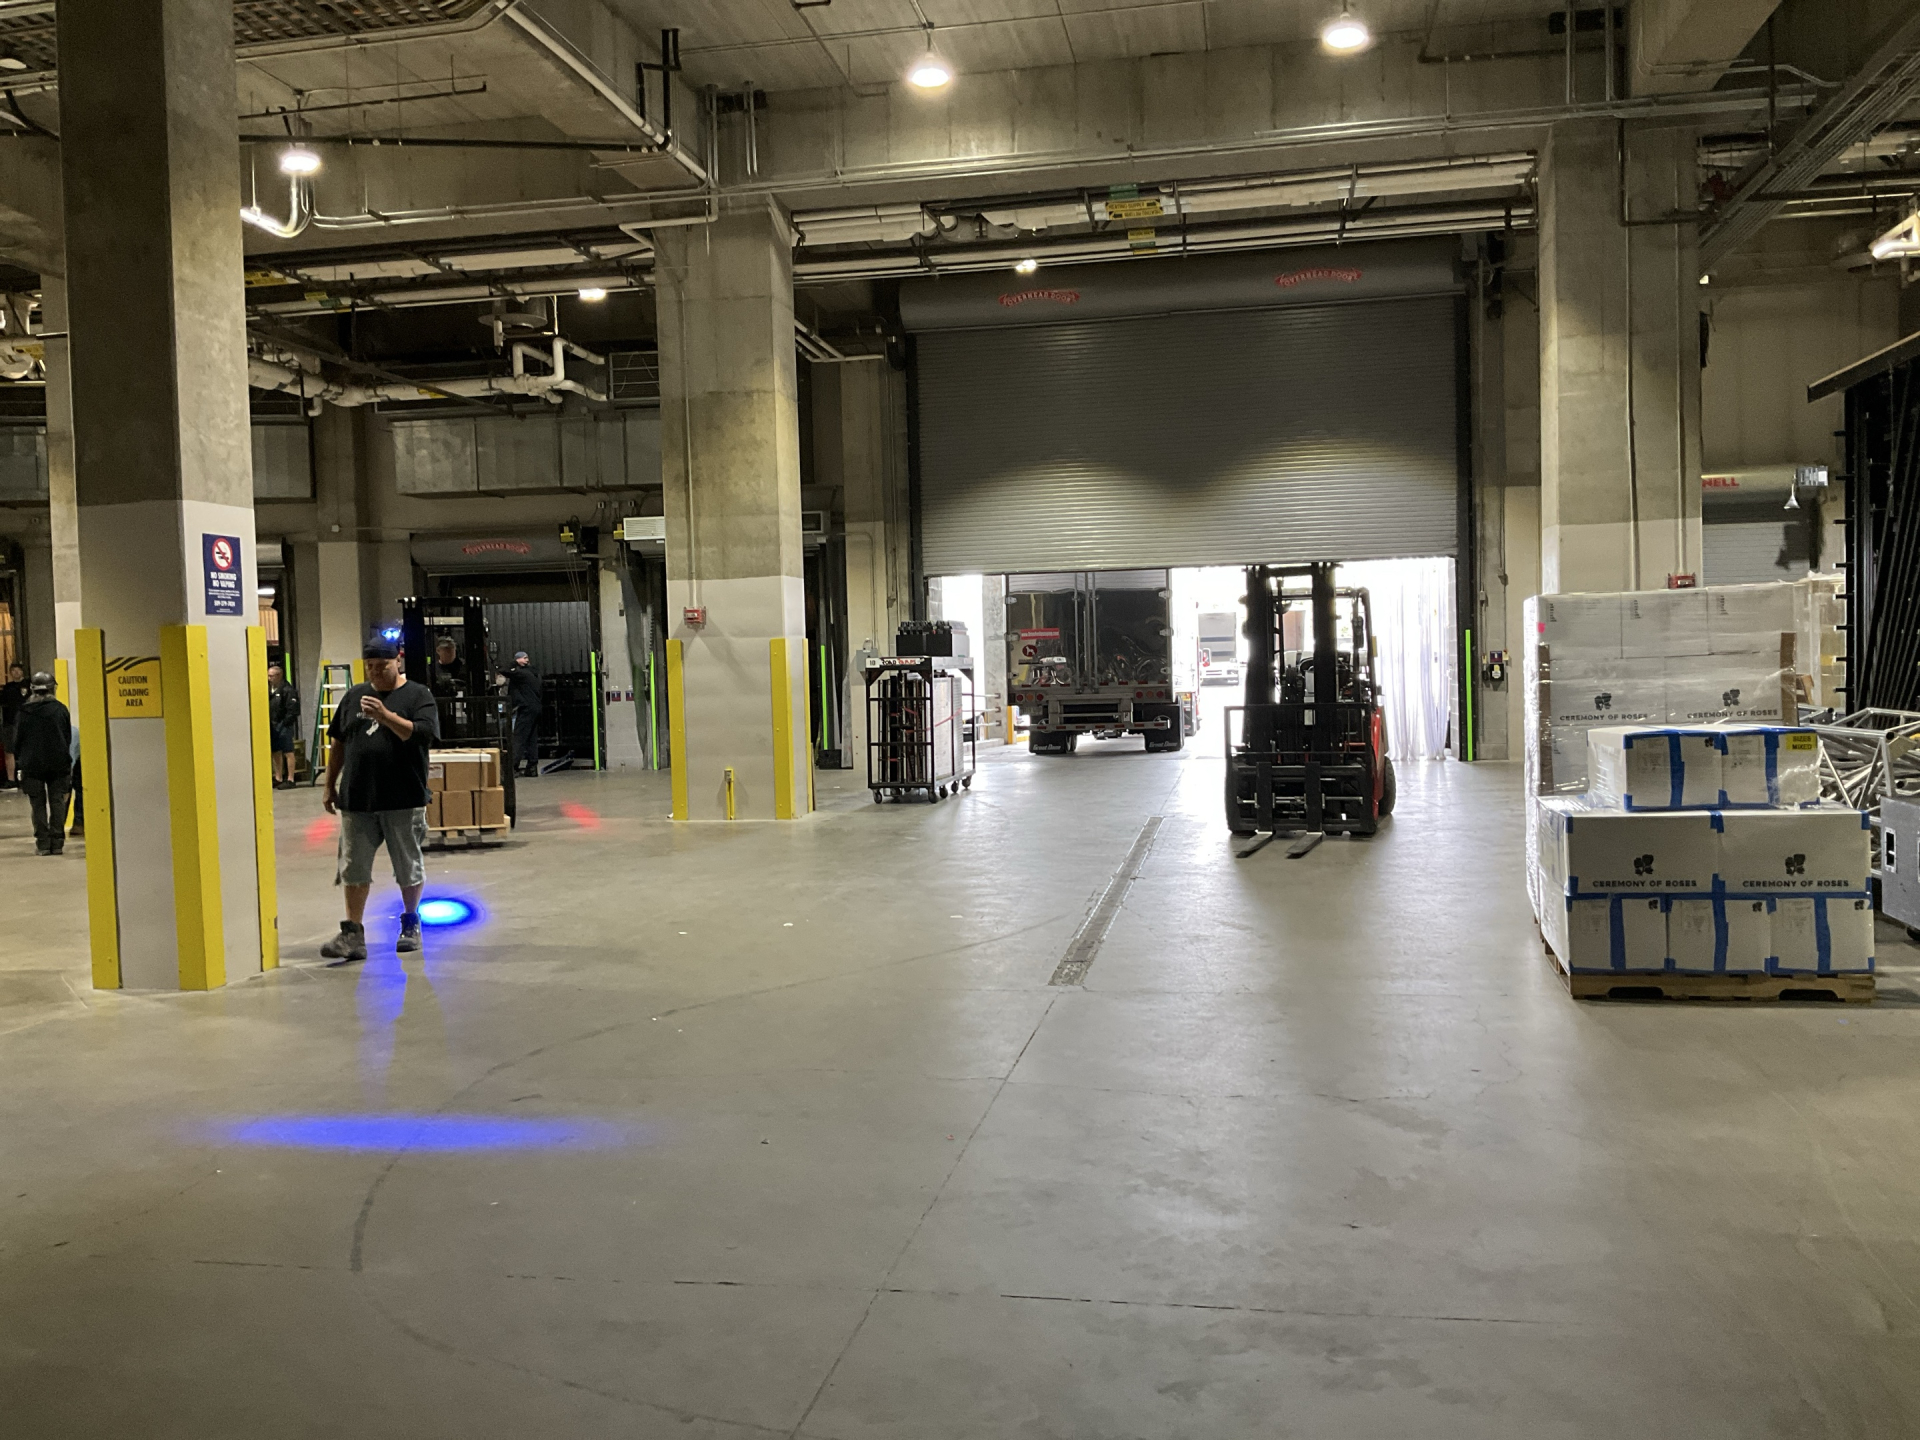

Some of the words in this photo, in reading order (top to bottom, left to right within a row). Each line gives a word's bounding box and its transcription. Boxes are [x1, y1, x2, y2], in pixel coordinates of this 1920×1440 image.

[1285, 271, 1329, 286] OVERHEAD
[1331, 271, 1353, 281] DOOR
[1008, 292, 1049, 306] OVERHEAD
[1050, 293, 1071, 303] DOOR
[210, 571, 218, 579] NO
[218, 572, 237, 581] SMOKING
[212, 579, 219, 587] NO
[220, 580, 235, 589] VAPING
[117, 676, 148, 684] CAUTION
[118, 688, 149, 697] LOADING
[125, 699, 144, 707] AREA
[1687, 711, 1733, 719] CEREMONY
